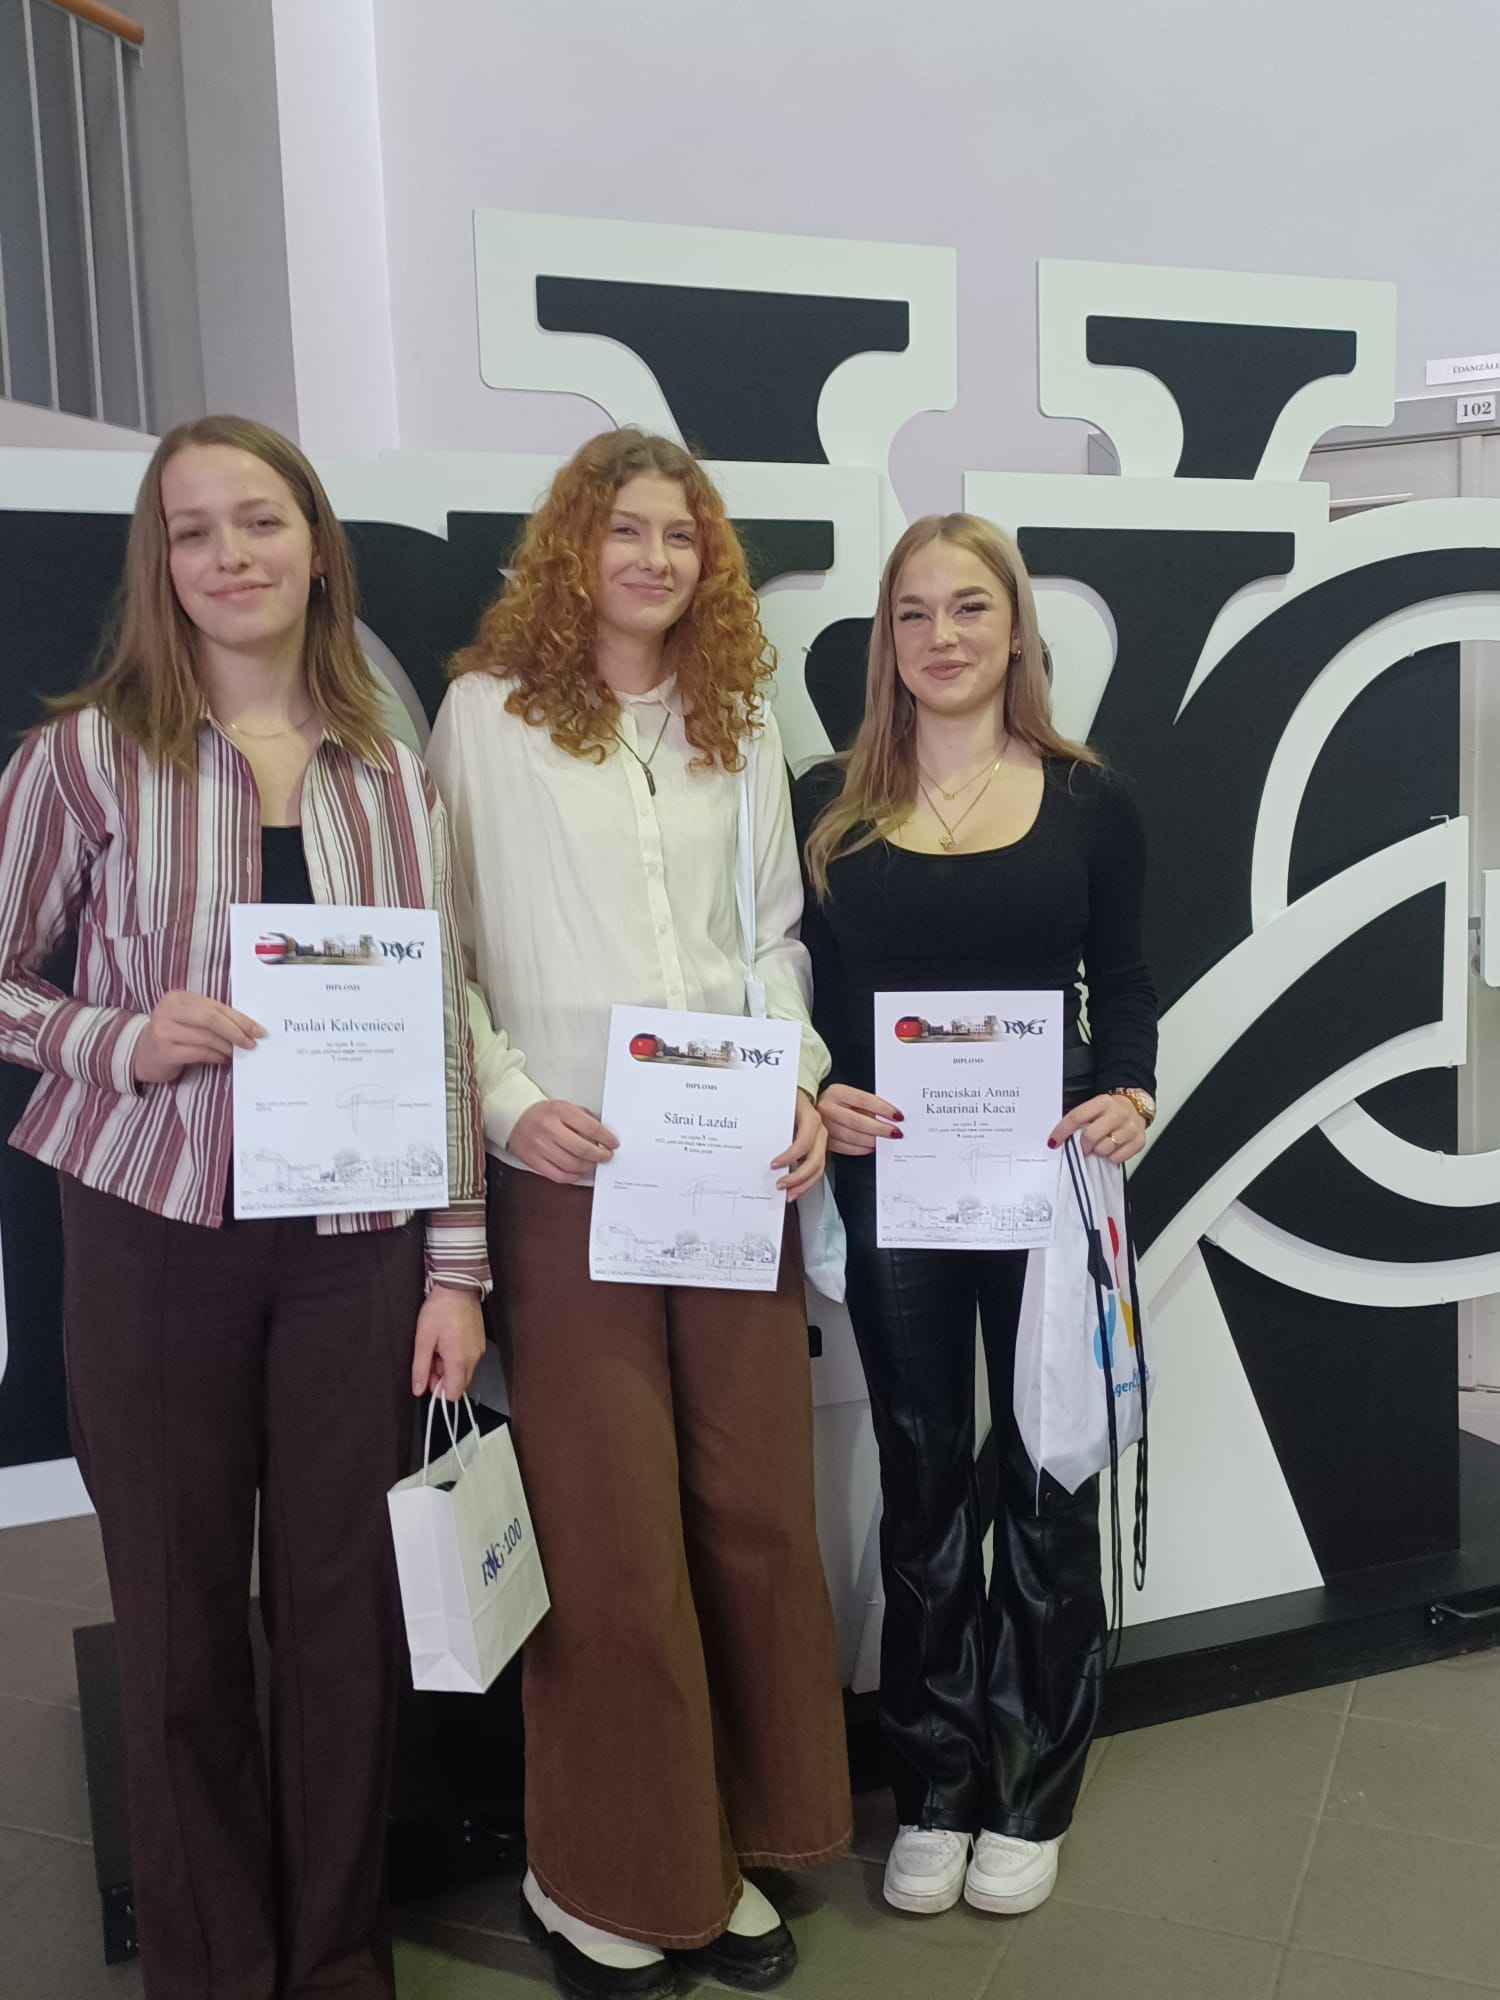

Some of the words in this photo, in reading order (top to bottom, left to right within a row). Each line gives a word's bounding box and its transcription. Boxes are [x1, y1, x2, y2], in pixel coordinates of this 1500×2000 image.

[1463, 401, 1491, 416] 102
[283, 1018, 326, 1032] Paulai
[922, 1086, 982, 1098] Franciskai
[984, 1086, 1020, 1098] Annai
[663, 1111, 694, 1126] Sārai
[698, 1114, 738, 1129] Lazdai
